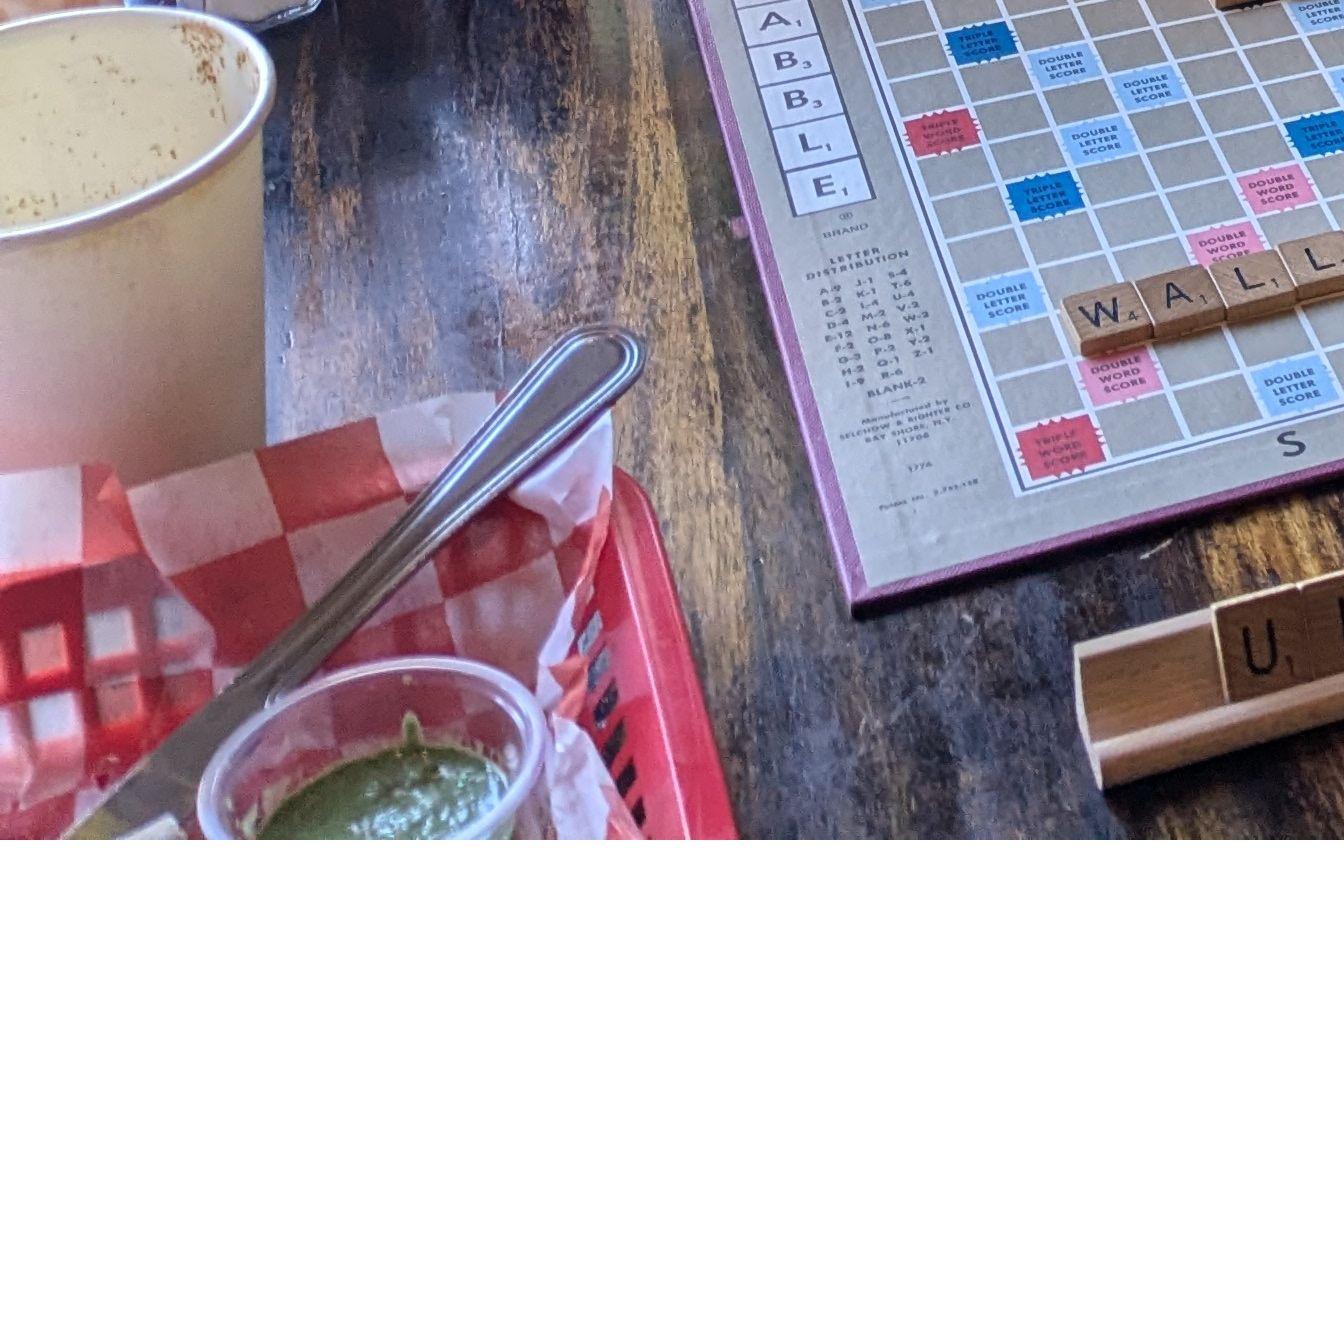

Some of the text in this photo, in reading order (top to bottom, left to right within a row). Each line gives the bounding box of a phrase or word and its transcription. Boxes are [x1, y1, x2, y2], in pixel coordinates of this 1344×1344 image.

[1038, 51, 1084, 65] DOUBLE
[1045, 59, 1083, 72] LETTER
[1048, 66, 1087, 79] SCORE
[1122, 74, 1168, 88] DOUBLE
[1129, 82, 1168, 95] LETTER
[1134, 89, 1173, 103] SCORE
[1297, 118, 1335, 132] TRIPLE
[1301, 126, 1341, 140] LETTER
[1246, 173, 1294, 189] DOUBLE
[1255, 182, 1295, 197] WORD
[1260, 190, 1300, 205] SCORE
[822, 223, 869, 239] BRAND
[830, 247, 881, 265] LETTER
[806, 249, 909, 281] DISTRIBUTION
[975, 282, 1027, 300] DOUBLE
[983, 293, 1026, 309] LETTER
[987, 301, 1031, 318] SCORE
[1089, 355, 1142, 374] DOUBLE
[1098, 366, 1141, 383] WORD
[1263, 367, 1315, 387] DOUBLE
[867, 377, 927, 398] BLANK-2
[1102, 376, 1147, 394] SCORE
[1272, 378, 1316, 396] LETTER
[1277, 388, 1322, 406] SCORE
